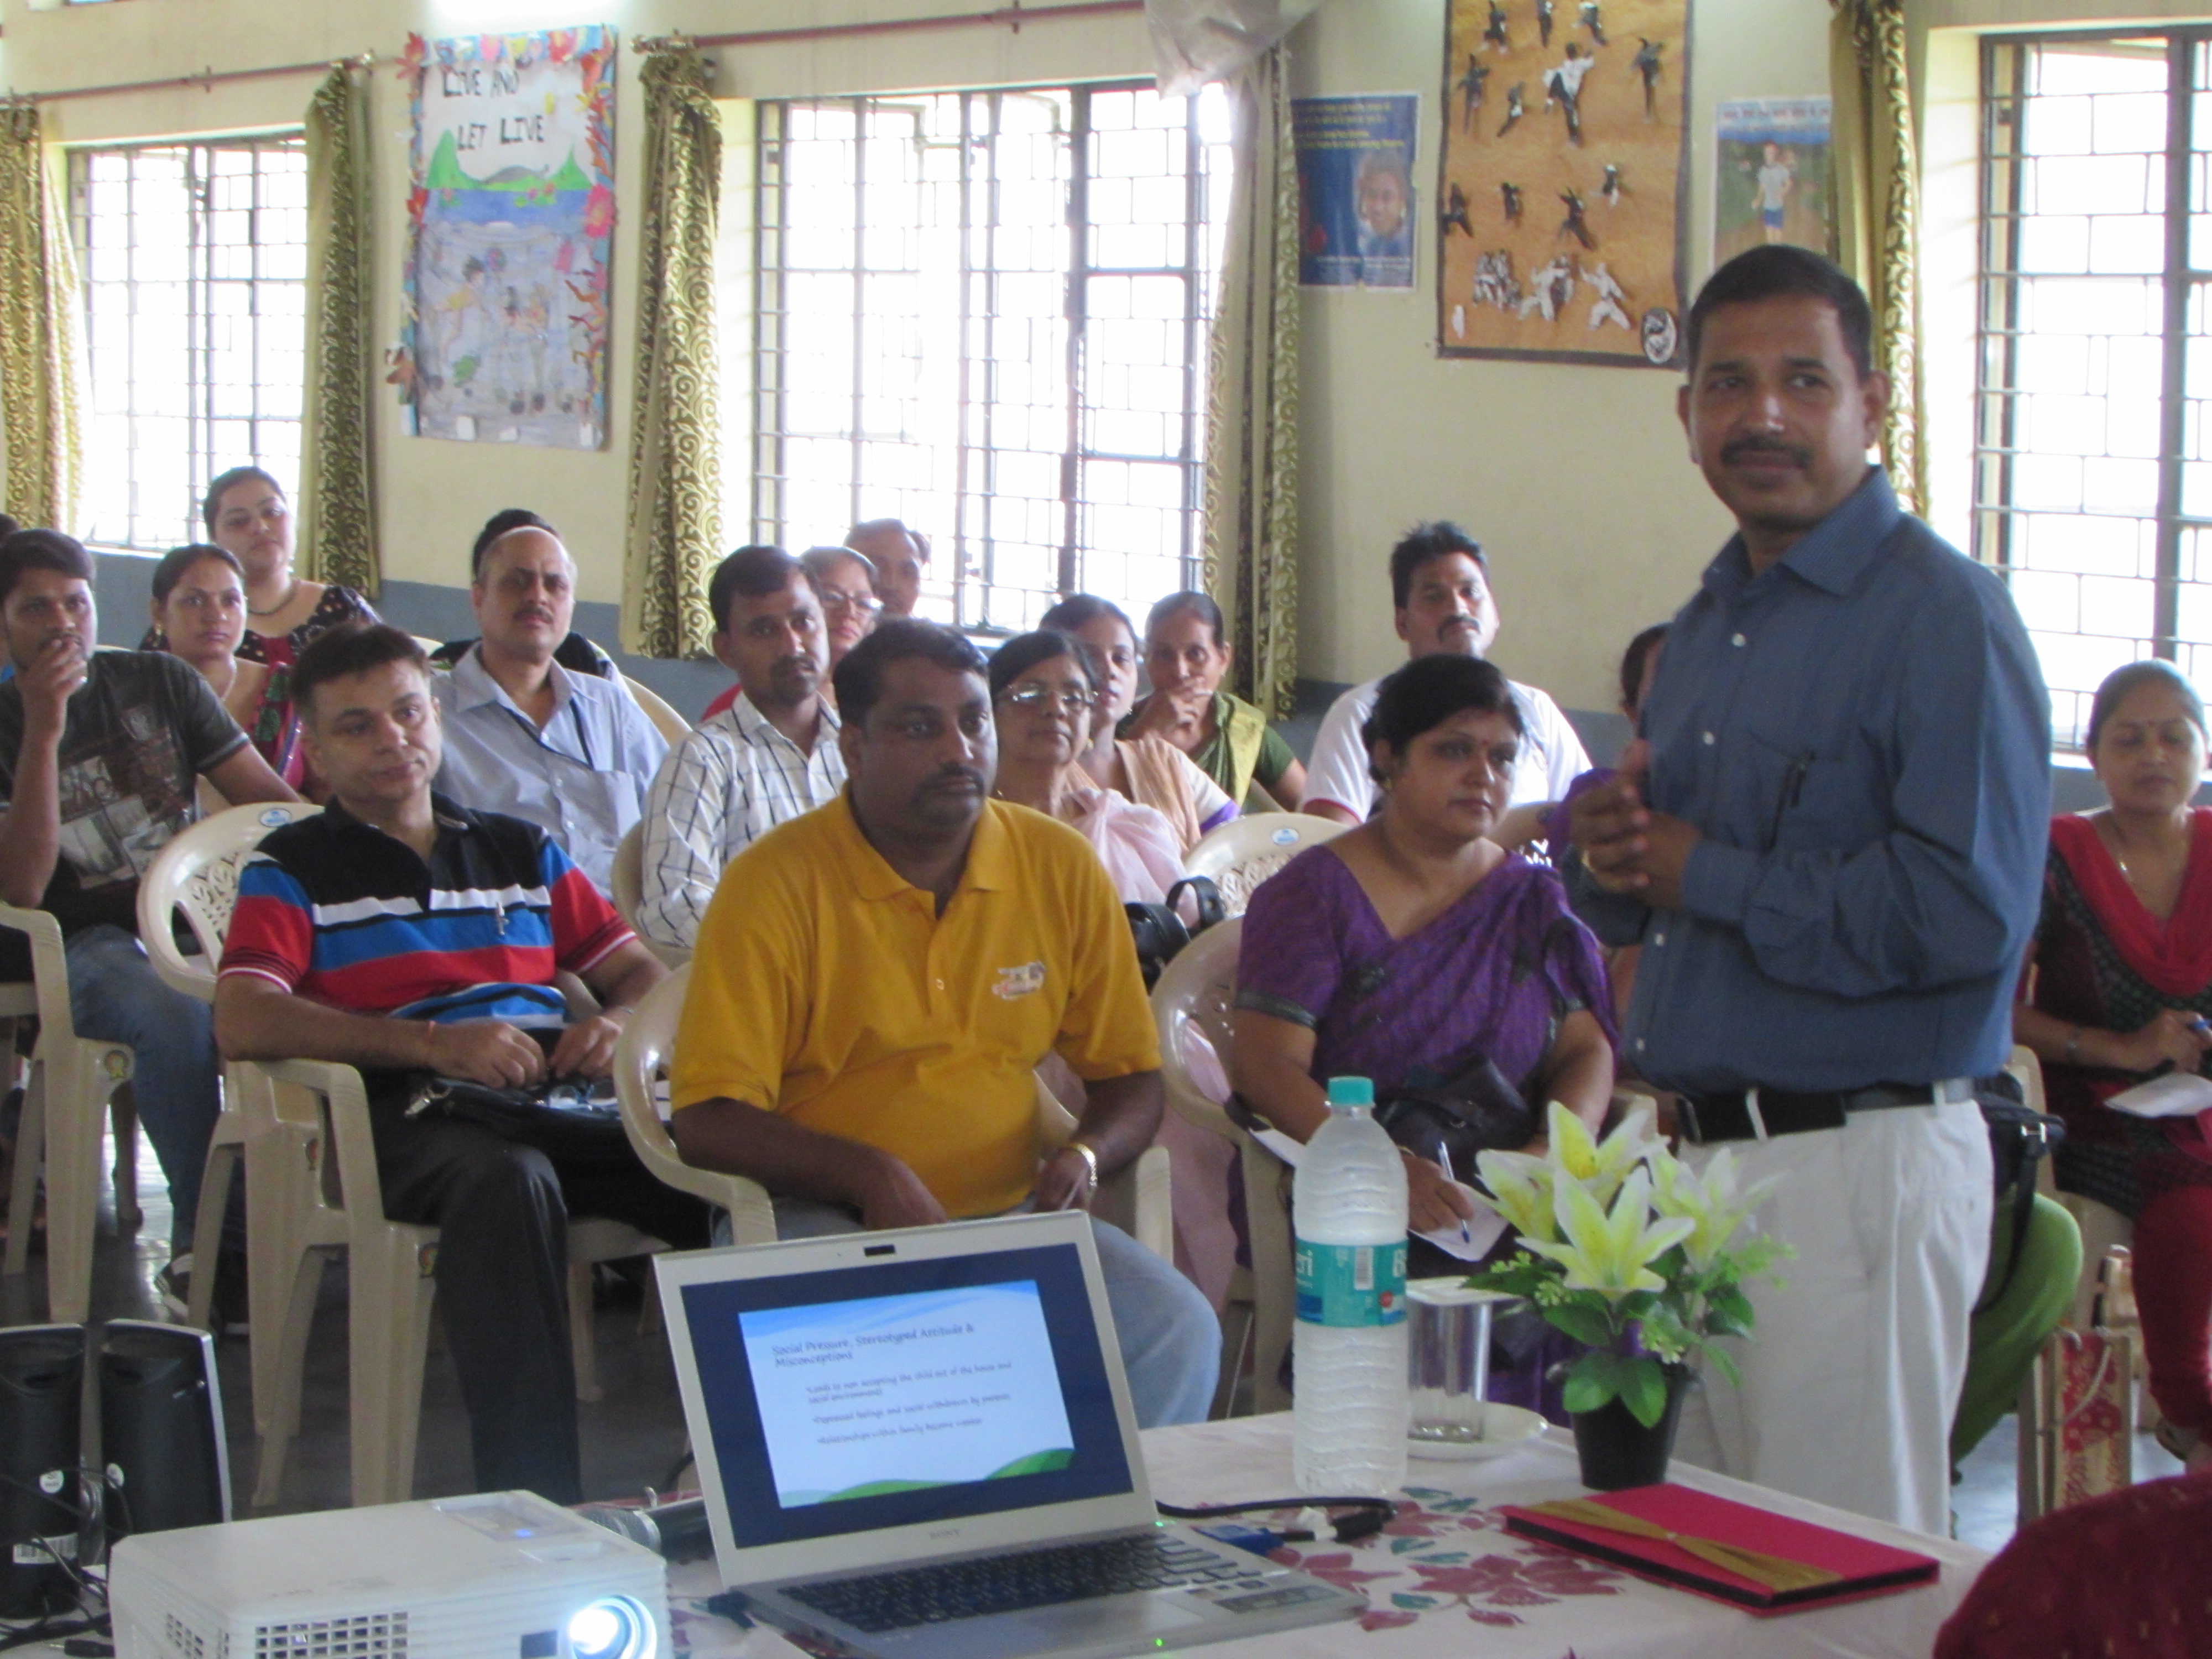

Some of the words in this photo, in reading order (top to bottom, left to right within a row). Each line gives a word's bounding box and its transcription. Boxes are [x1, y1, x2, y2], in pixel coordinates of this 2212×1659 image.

[457, 123, 487, 152] LET
[500, 114, 544, 144] LIVE
[773, 1342, 803, 1355] Social
[855, 1328, 916, 1344] Stereotyped
[921, 1324, 963, 1337] Attitude
[966, 1323, 973, 1333] &
[775, 1351, 853, 1368] Misconceptions
